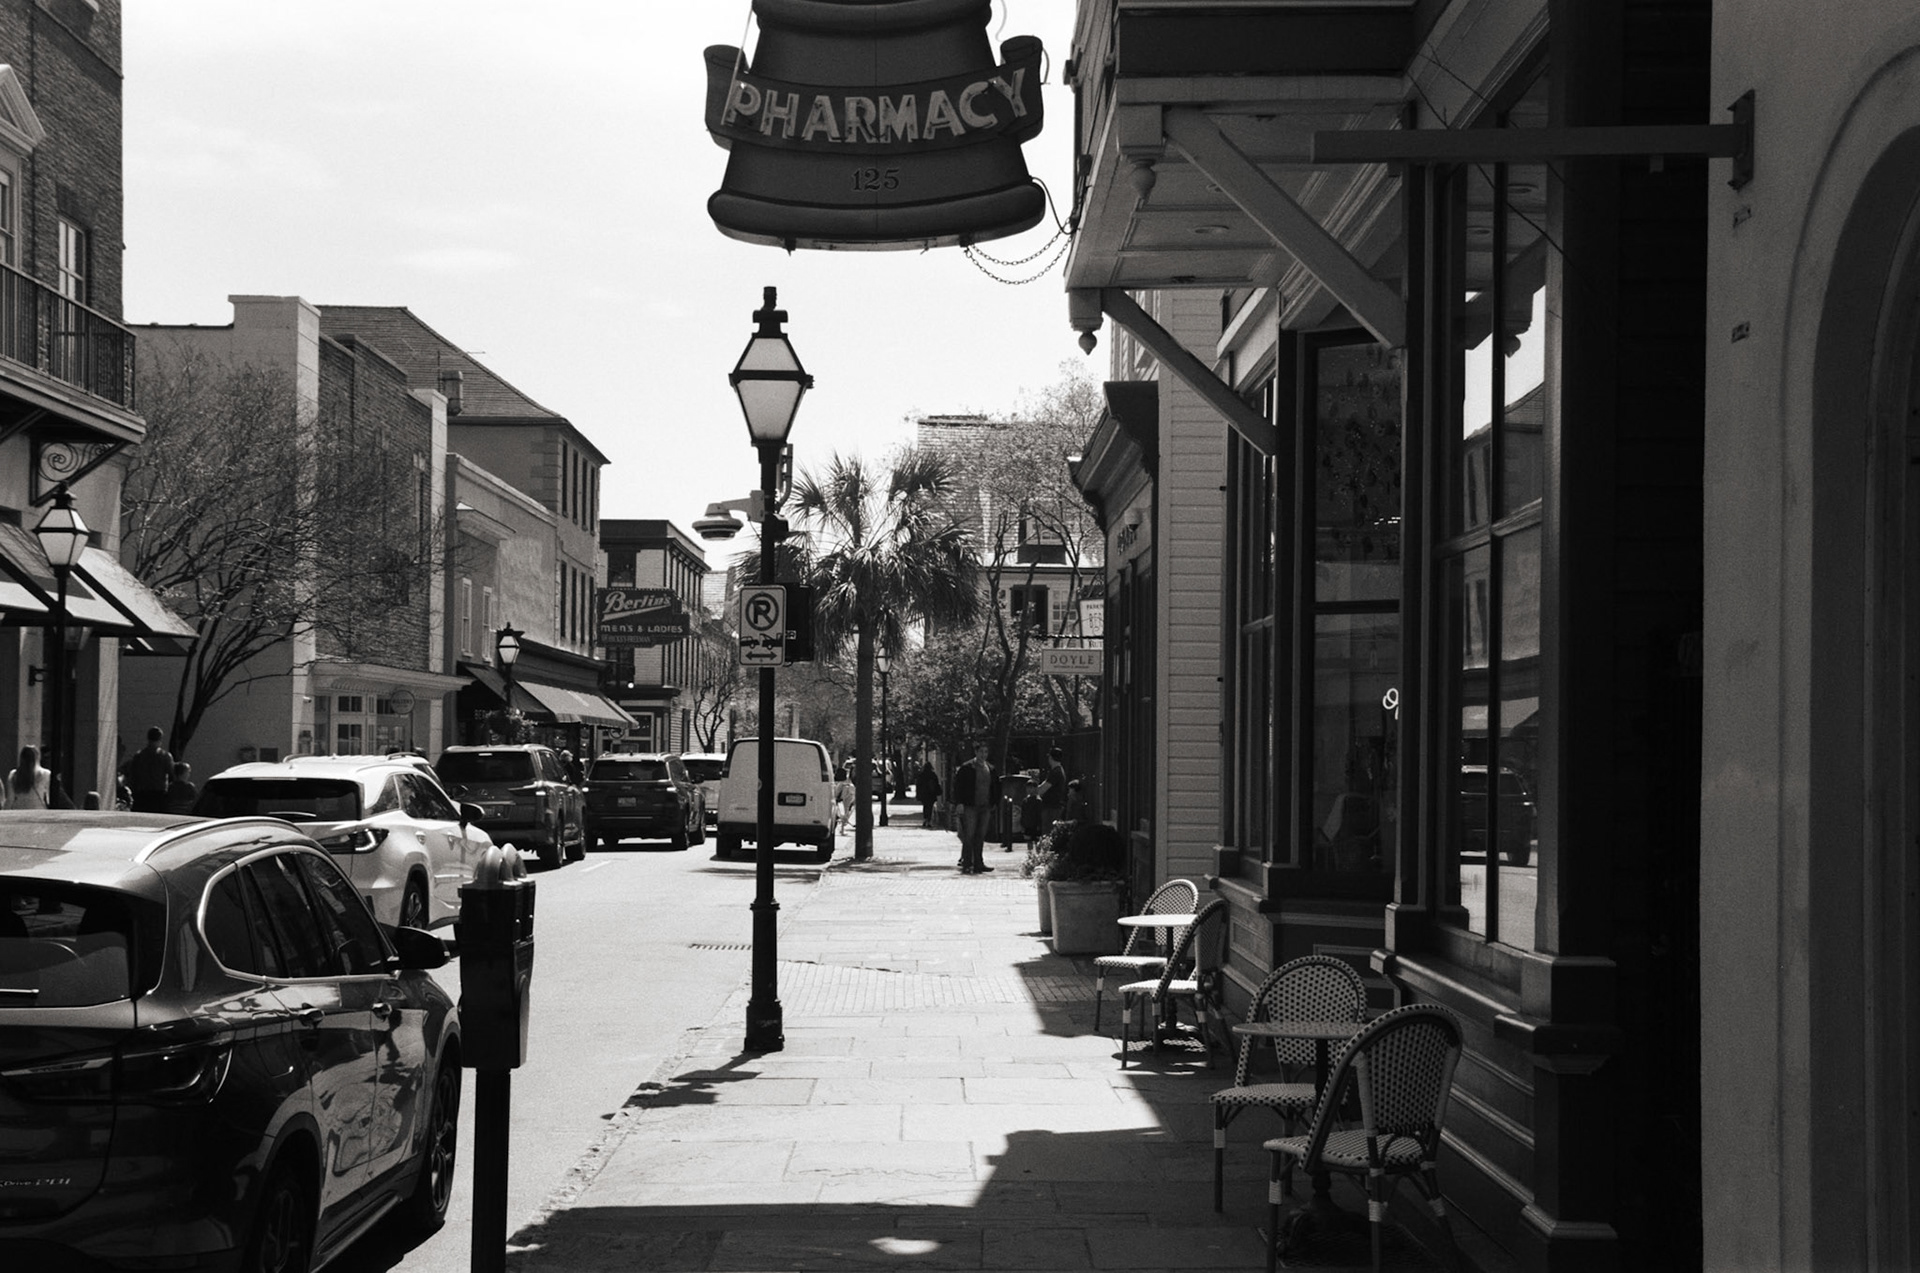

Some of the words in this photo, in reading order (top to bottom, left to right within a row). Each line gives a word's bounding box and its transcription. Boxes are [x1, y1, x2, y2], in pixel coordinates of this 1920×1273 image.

[724, 67, 1028, 144] PHARMACY
[852, 168, 900, 191] 125
[602, 591, 672, 613] Berlin's
[647, 624, 684, 633] LADIES
[1050, 654, 1094, 665] DOYLE
